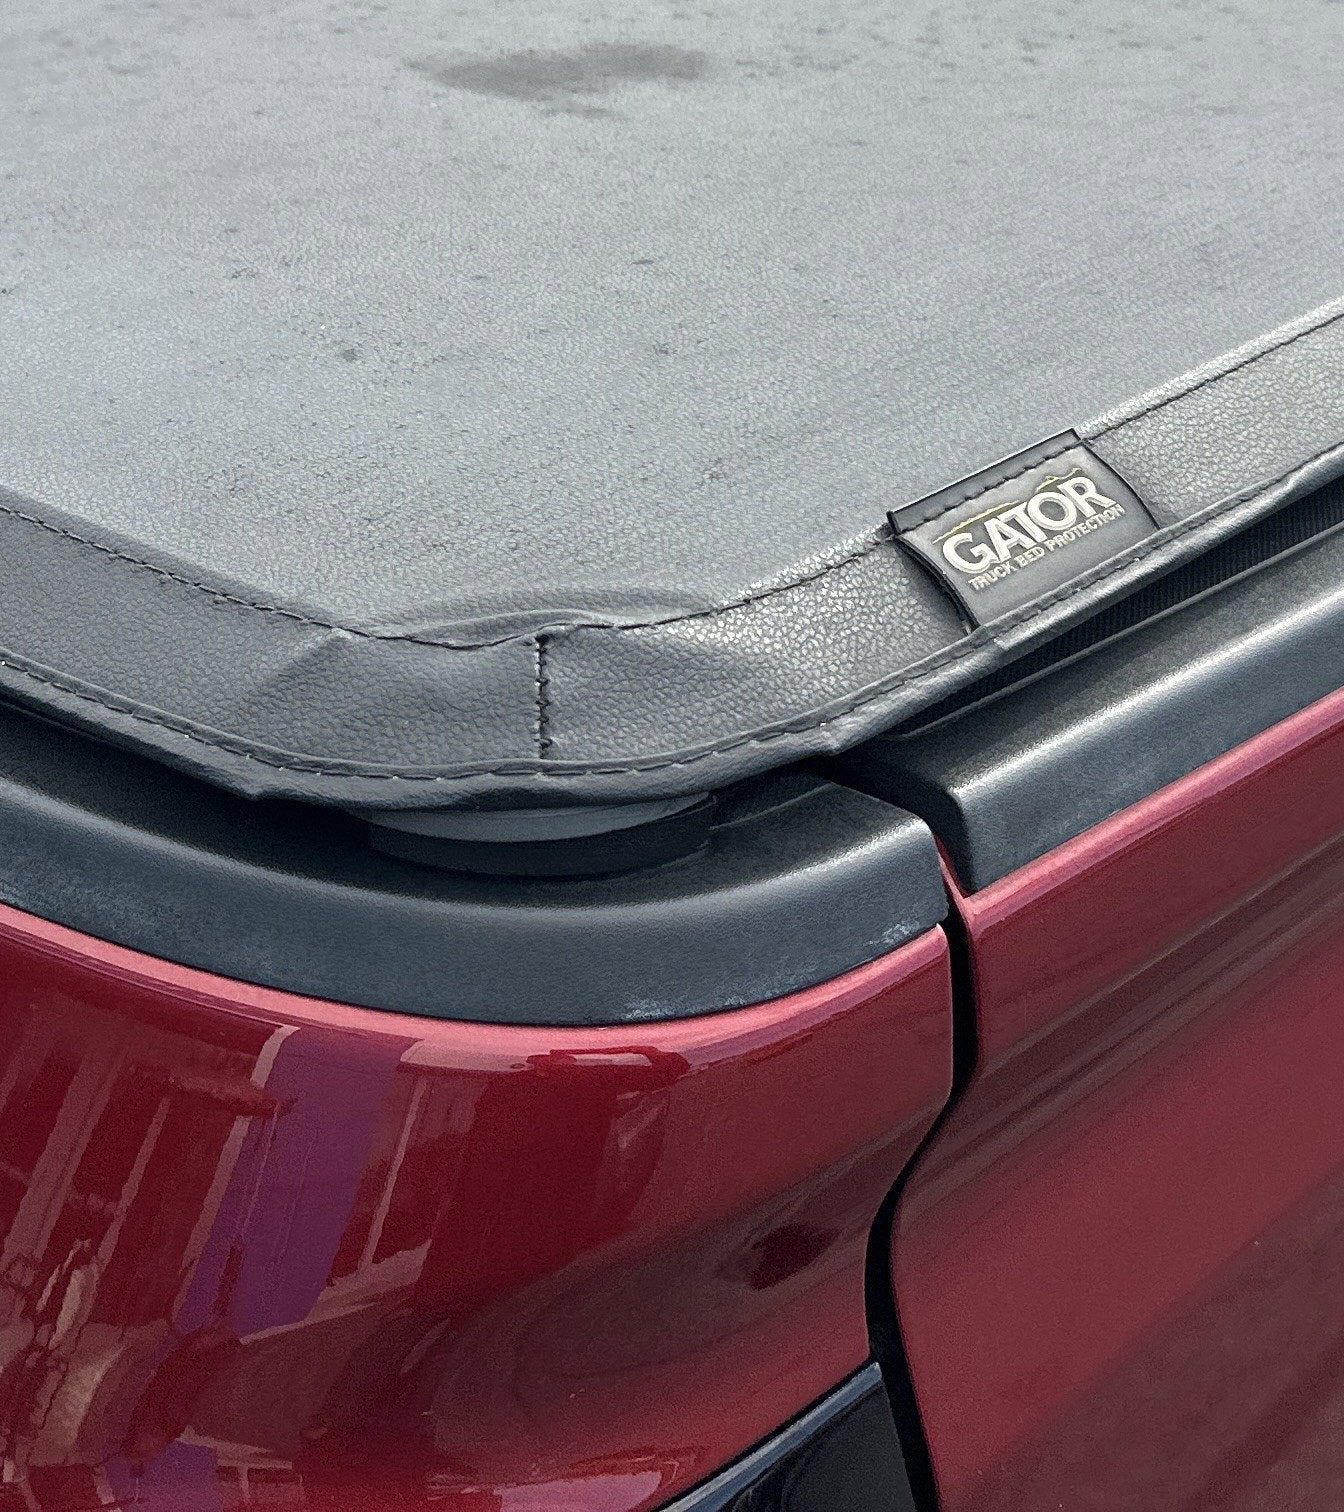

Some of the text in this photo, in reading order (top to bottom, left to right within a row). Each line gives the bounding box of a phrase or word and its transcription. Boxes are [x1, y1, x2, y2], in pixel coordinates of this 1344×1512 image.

[942, 476, 1117, 574] GATOR
[968, 503, 1126, 590] TRUCK BED PROTECTION
